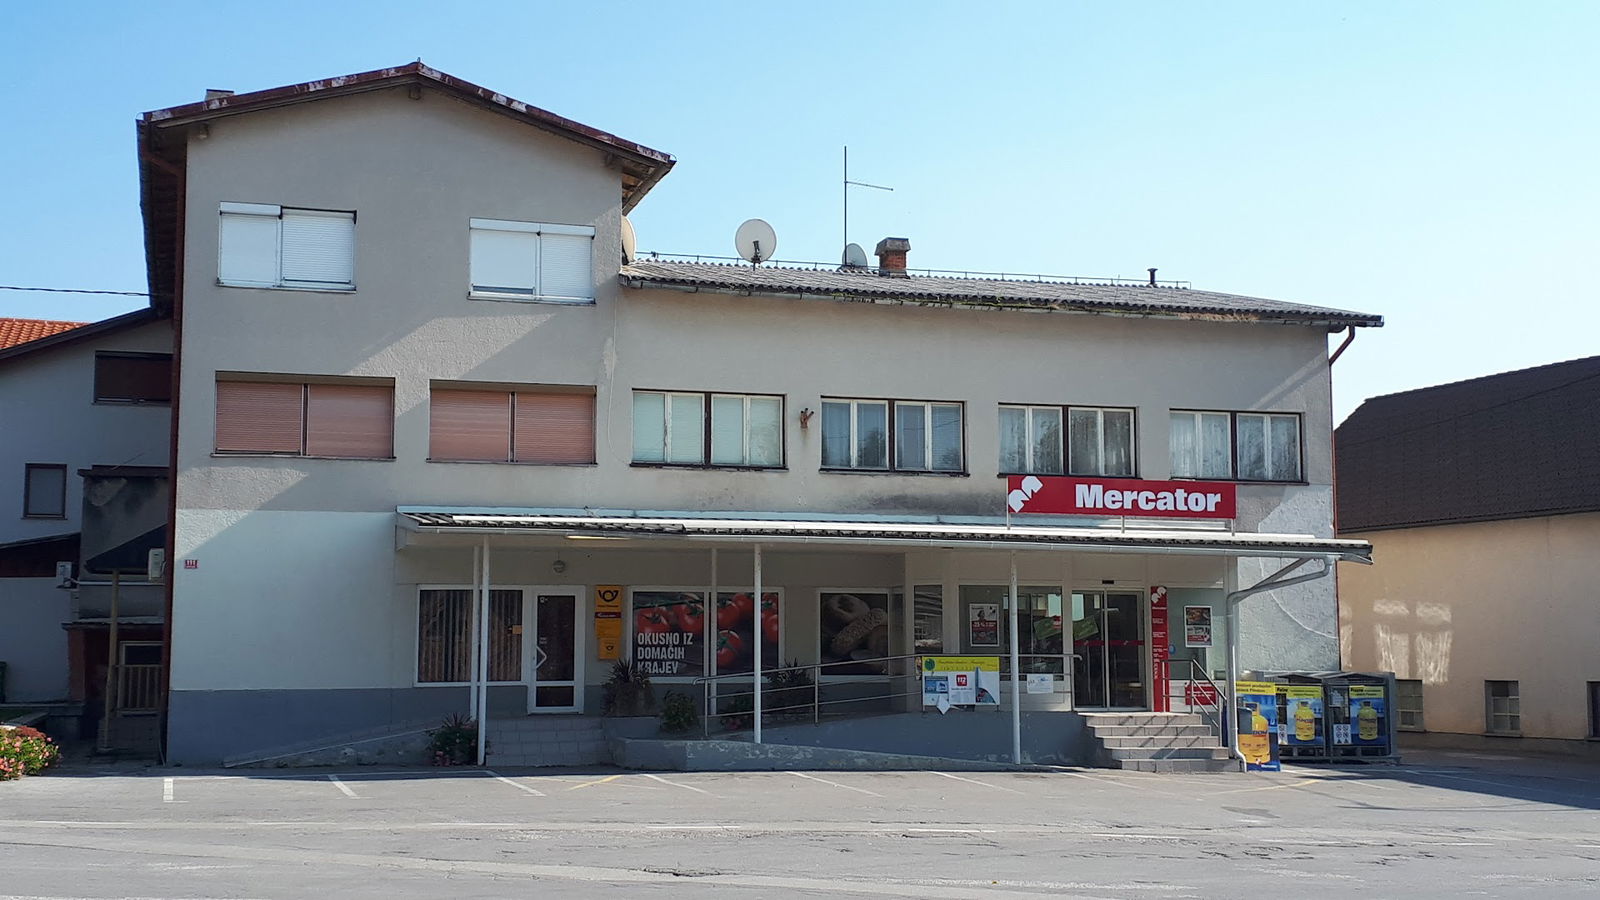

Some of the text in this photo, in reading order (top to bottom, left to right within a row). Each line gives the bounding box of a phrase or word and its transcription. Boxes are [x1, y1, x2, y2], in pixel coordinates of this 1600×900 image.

[1075, 484, 1221, 512] Mercator
[637, 632, 693, 645] OKUSNO IZ
[637, 644, 684, 659] DOMAČIH
[637, 661, 678, 674] KRAJEV
